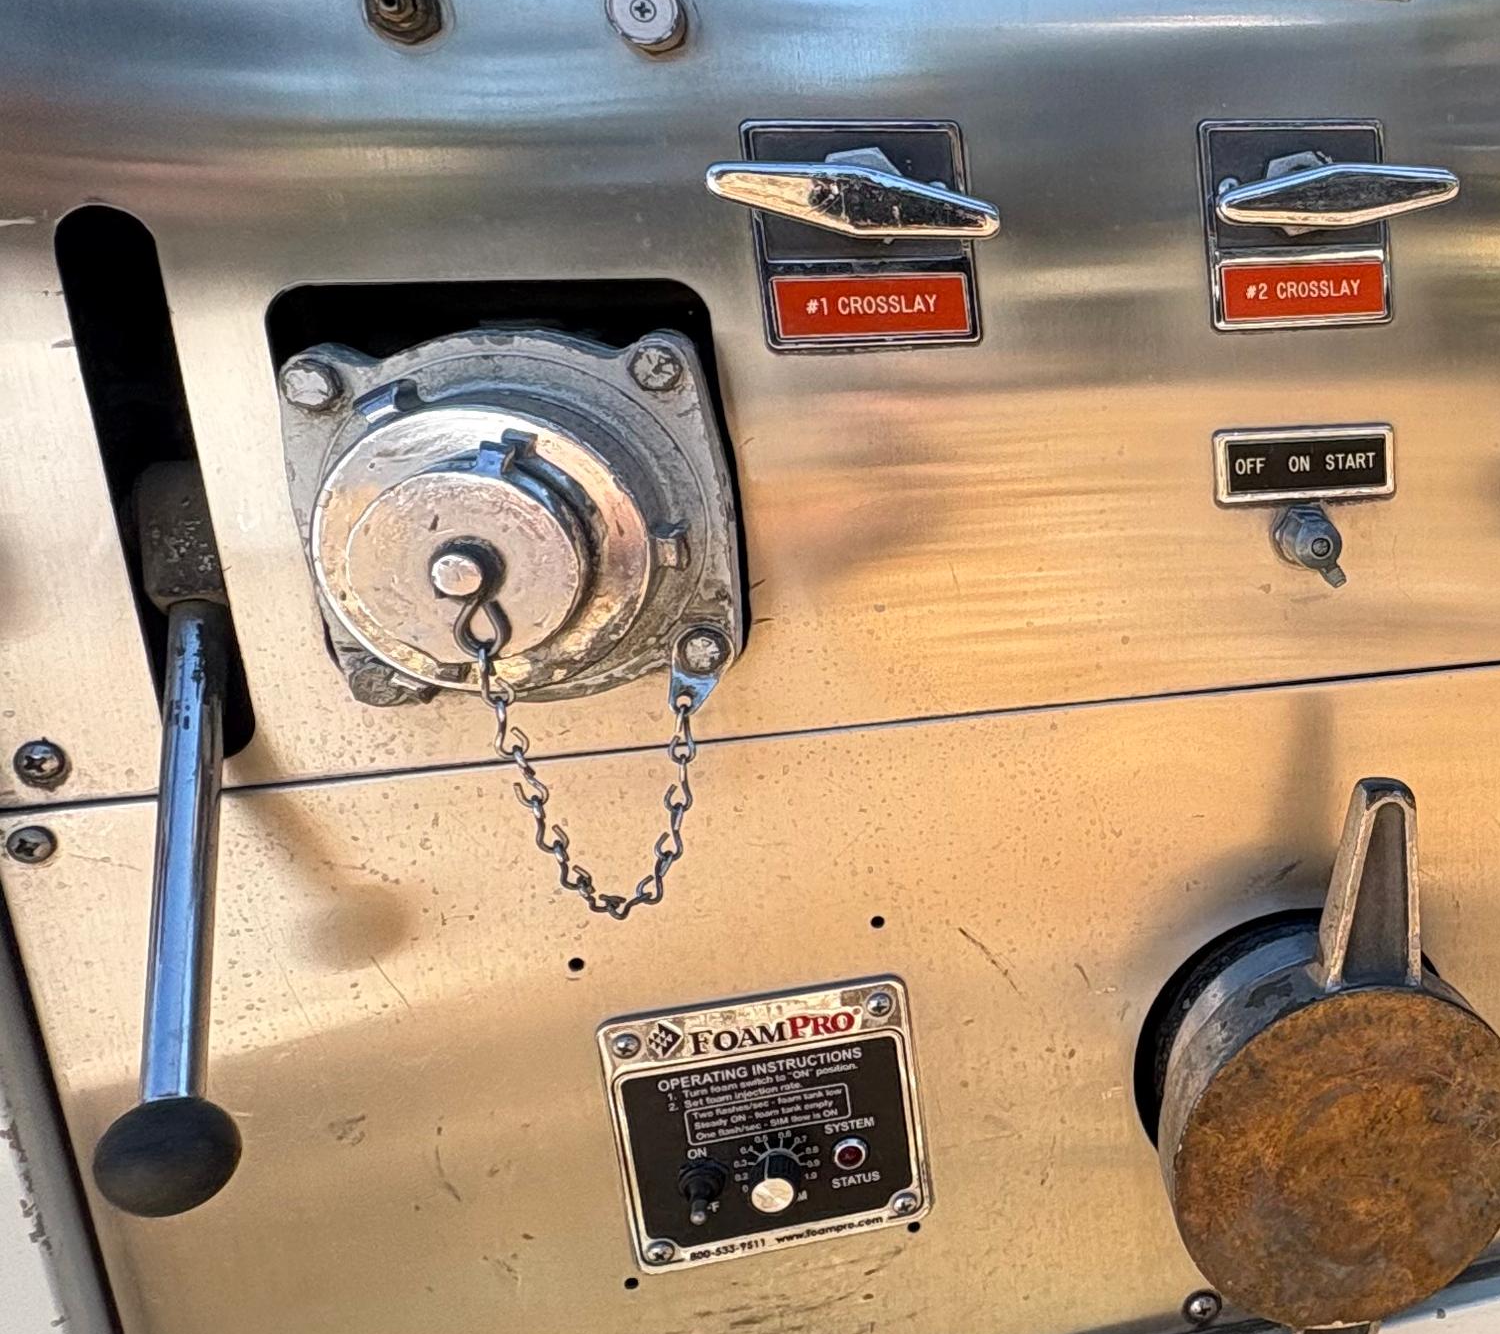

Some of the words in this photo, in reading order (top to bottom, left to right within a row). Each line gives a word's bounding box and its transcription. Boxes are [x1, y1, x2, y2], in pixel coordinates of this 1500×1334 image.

[1246, 283, 1269, 300] #2
[1276, 278, 1360, 300] CROSSLAY
[806, 296, 829, 316] #1
[837, 294, 938, 316] CROSSLAY
[1235, 456, 1266, 476] OFF
[1288, 453, 1311, 472] ON
[1325, 451, 1376, 471] START
[657, 1067, 748, 1092] OPERATING
[752, 1047, 862, 1075] INSTRUCTIONS
[824, 1117, 875, 1135] SYSTEM
[687, 1147, 707, 1159] ON
[832, 1171, 880, 1189] STATUS
